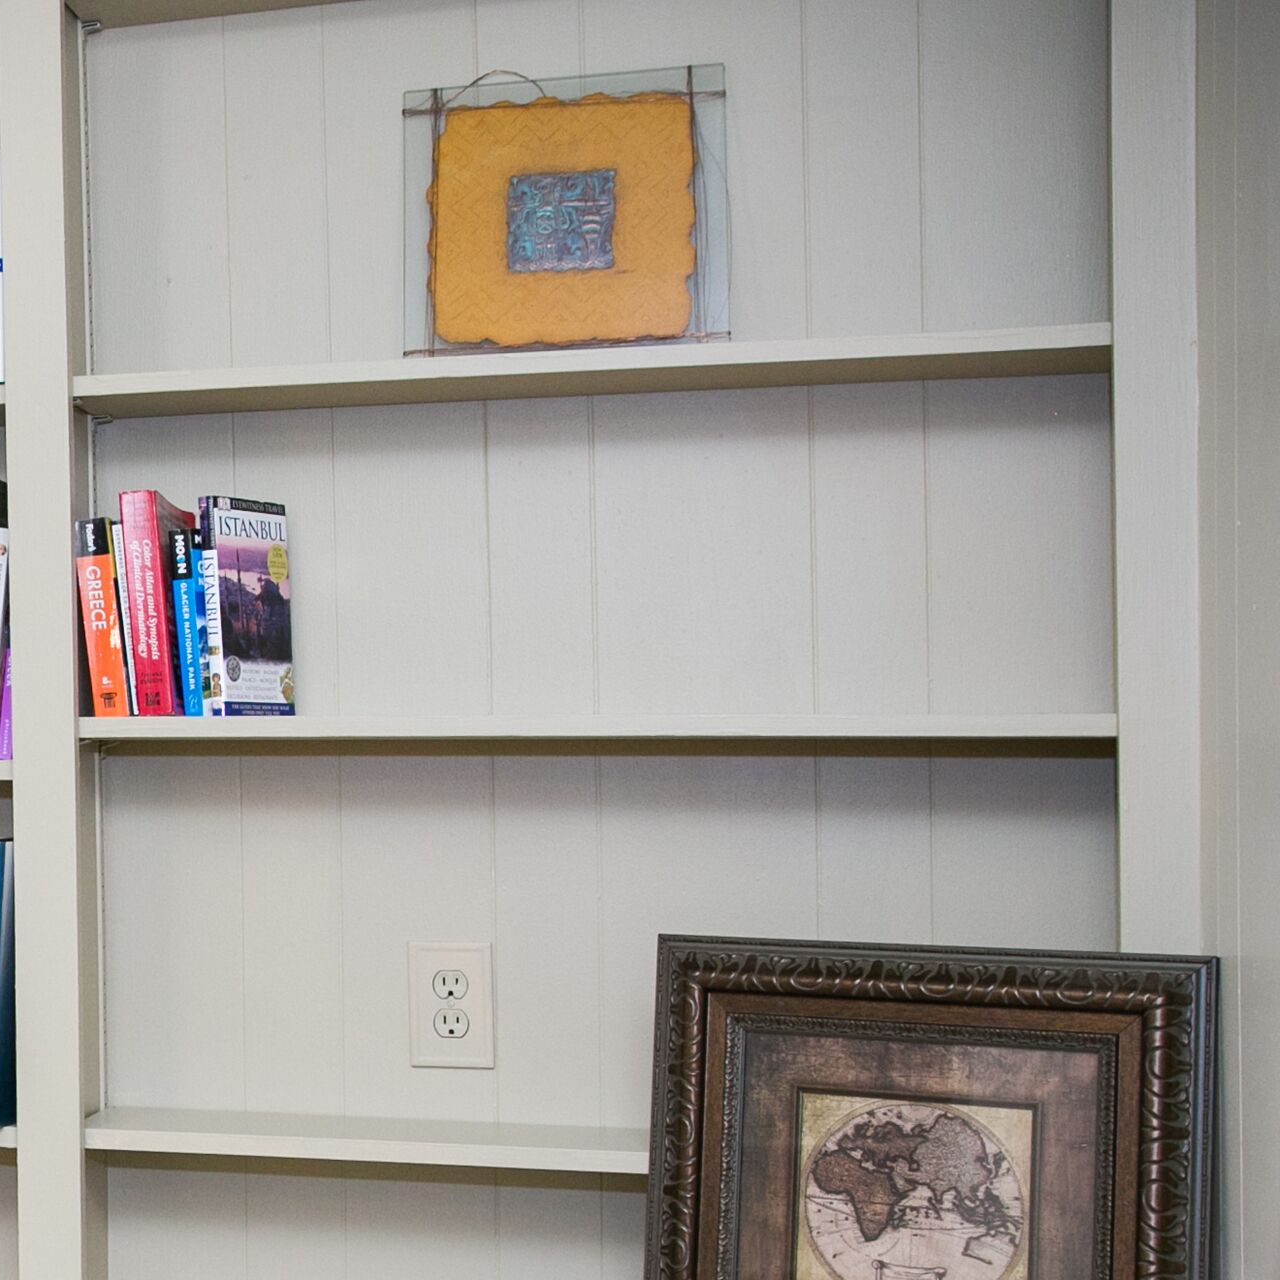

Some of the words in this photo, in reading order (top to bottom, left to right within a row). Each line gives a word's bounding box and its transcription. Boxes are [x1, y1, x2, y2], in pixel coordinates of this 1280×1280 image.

[84, 523, 96, 552] Fodor's
[129, 540, 140, 550] of
[219, 516, 286, 542] ISTANBUL
[130, 551, 144, 590] Clinical
[141, 539, 153, 566] Color
[174, 535, 186, 574] MOON
[85, 565, 106, 630] GREECE
[144, 568, 156, 594] Atlas
[204, 557, 219, 636] ISTANBUL
[147, 595, 158, 614] and
[180, 582, 190, 619] GLACIER
[134, 592, 150, 658] Dermatology
[147, 616, 162, 659] Synopsis
[183, 621, 194, 664] NATIONAL
[187, 666, 196, 689] PARK
